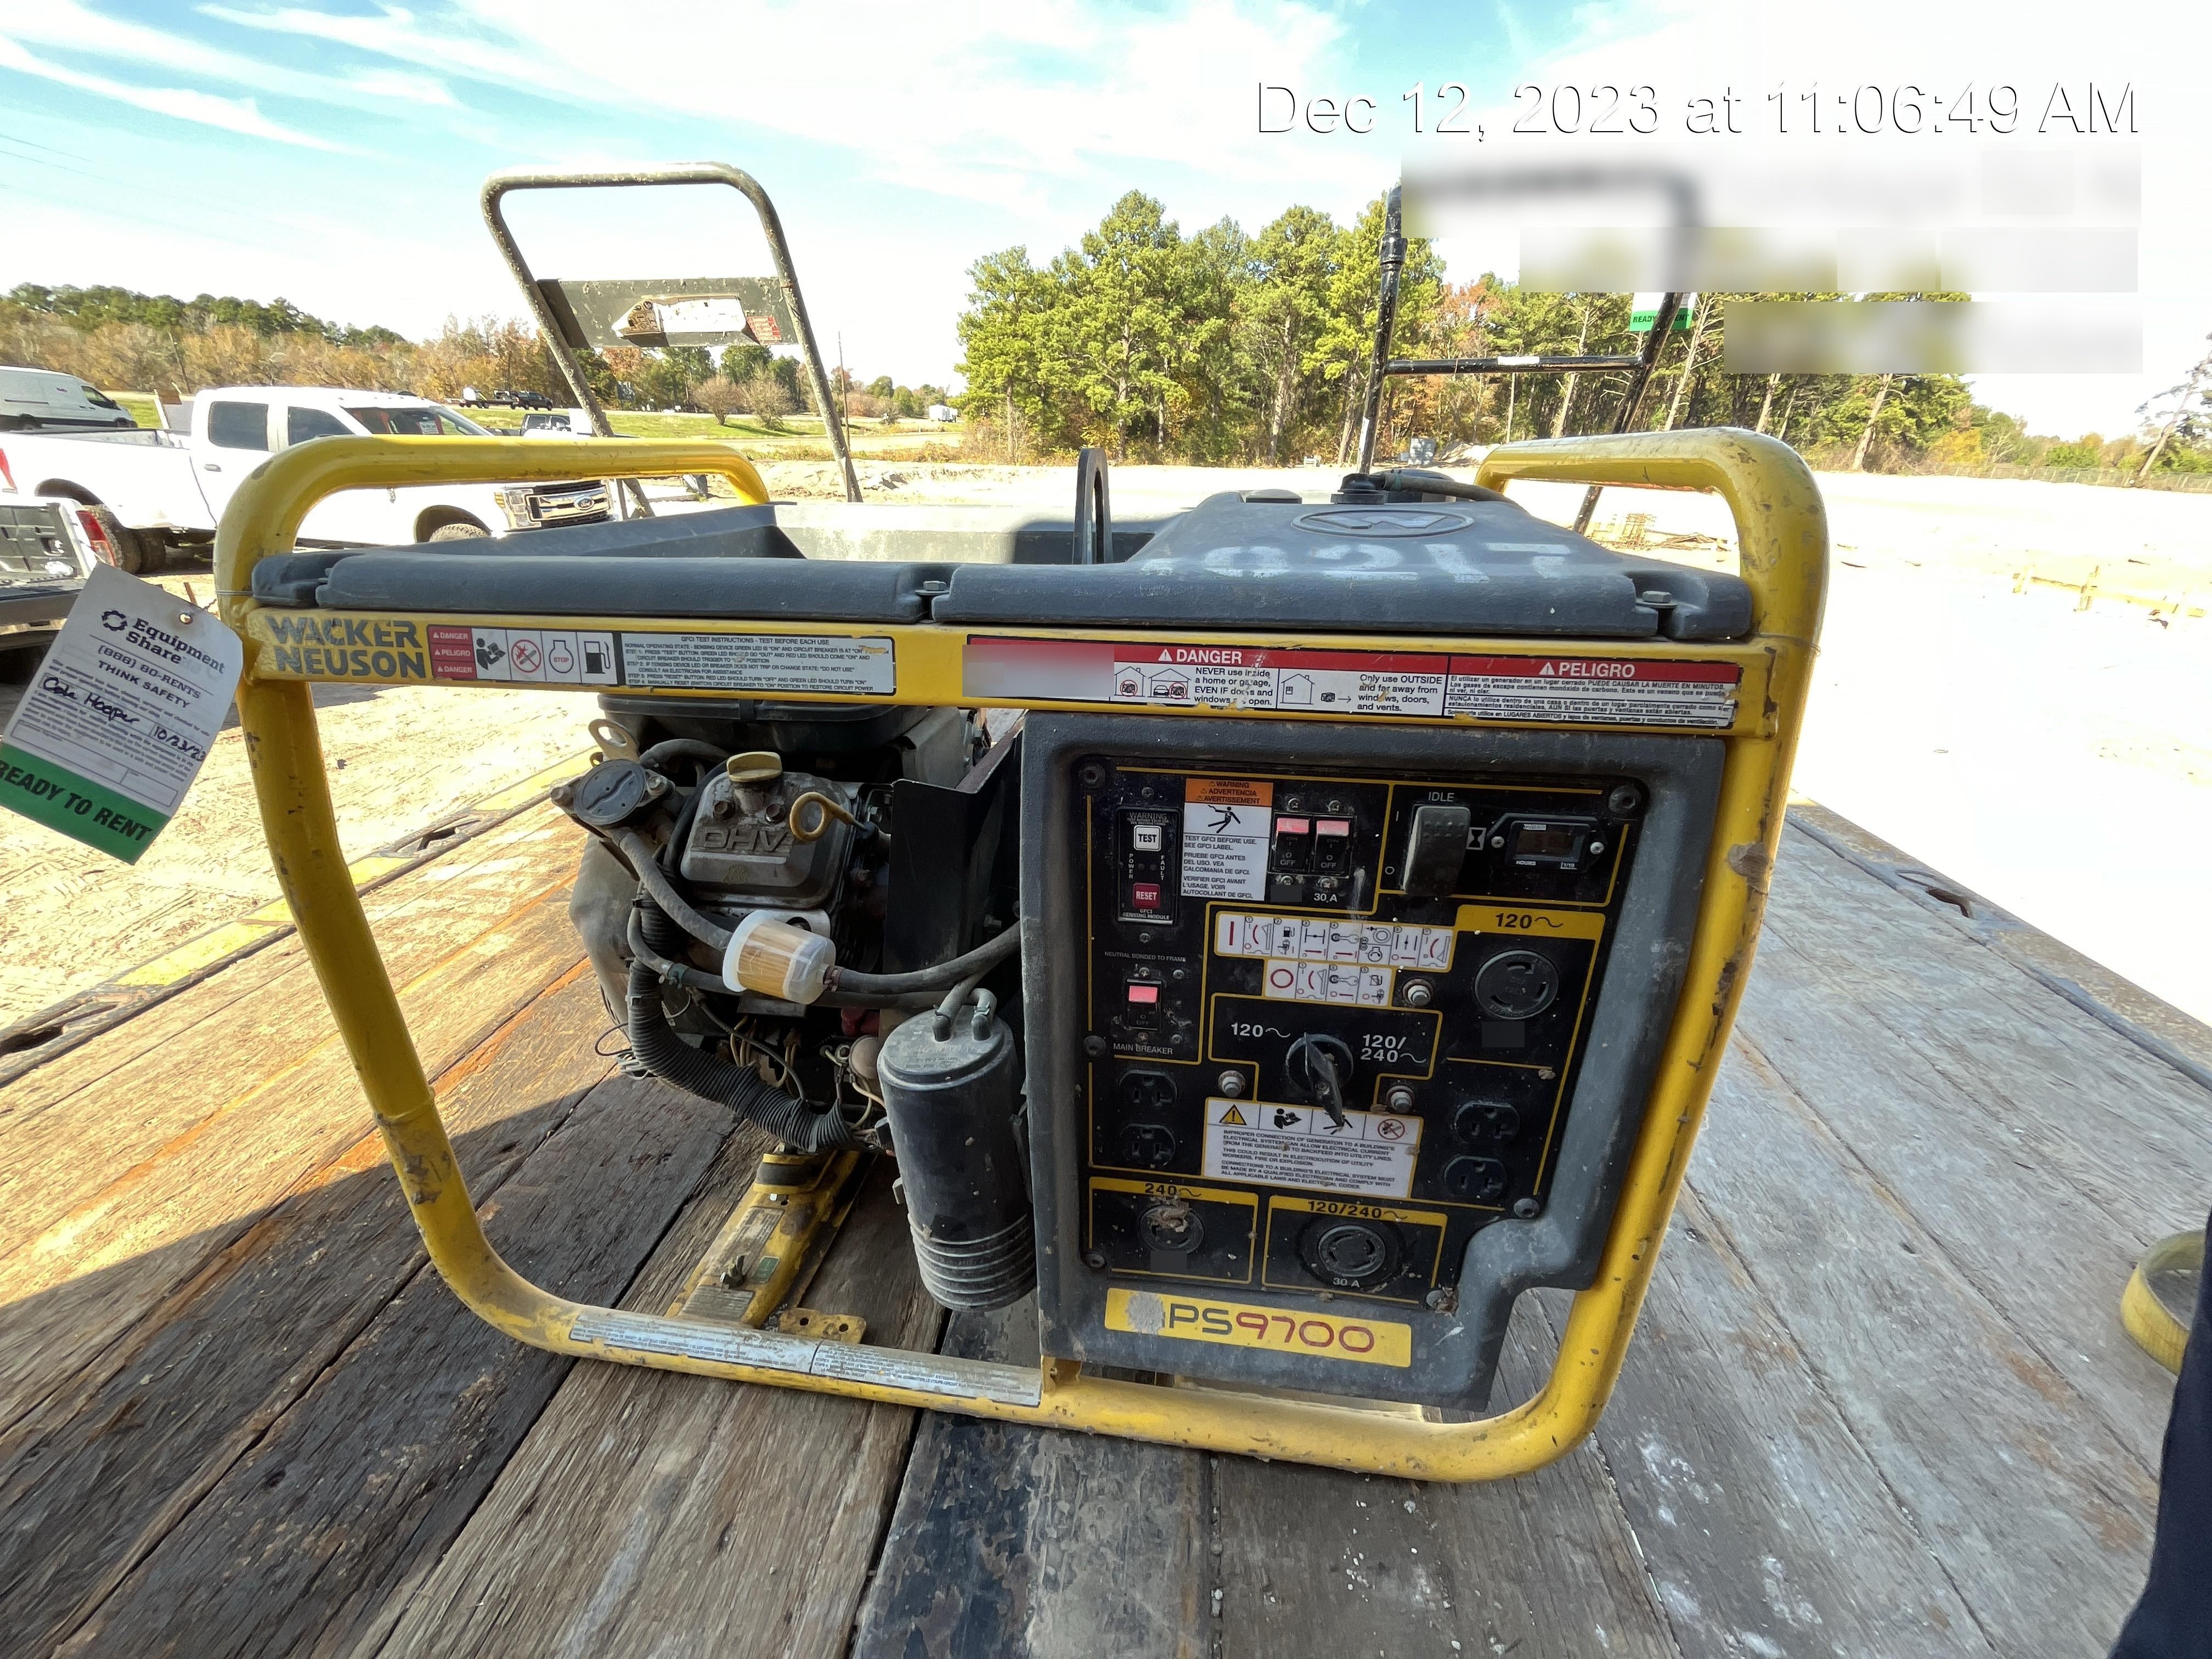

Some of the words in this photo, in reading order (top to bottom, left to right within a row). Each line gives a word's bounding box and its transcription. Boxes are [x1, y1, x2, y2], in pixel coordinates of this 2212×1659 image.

[265, 616, 422, 648] WACKER
[126, 631, 182, 664] Share
[132, 618, 225, 674] Equipment
[274, 646, 426, 678] NEUSON
[1176, 649, 1242, 664] DANGER
[98, 645, 137, 668] (888)
[140, 664, 201, 699] 80-RENTS
[1559, 662, 1635, 678] PELIGRO
[99, 660, 140, 685] THINK
[142, 681, 190, 708] SAFETY
[1360, 674, 1380, 684] Only
[1401, 675, 1442, 684] OUTSIDE
[1358, 694, 1399, 703] windws,
[1402, 696, 1430, 704] doors,
[0, 760, 66, 800] READY
[64, 793, 92, 815] TO
[93, 808, 153, 841] RENT
[1428, 792, 1454, 802] IDLE
[1129, 812, 1167, 820] WARNING
[1138, 834, 1157, 843] TEST
[1136, 891, 1157, 900] RESET
[1313, 893, 1327, 901] 30
[1496, 912, 1532, 929] 120
[1231, 1023, 1263, 1037] 120
[1113, 1043, 1133, 1051] MAIN
[1136, 1045, 1173, 1054] BREAKER
[1362, 1034, 1406, 1049] 120/
[1360, 1048, 1398, 1063] 240
[1144, 1183, 1177, 1196] 240
[1308, 1200, 1383, 1219] 120/240
[1333, 1277, 1347, 1287] 30
[1350, 1279, 1360, 1288] A
[1163, 1302, 1375, 1353] PS9700
